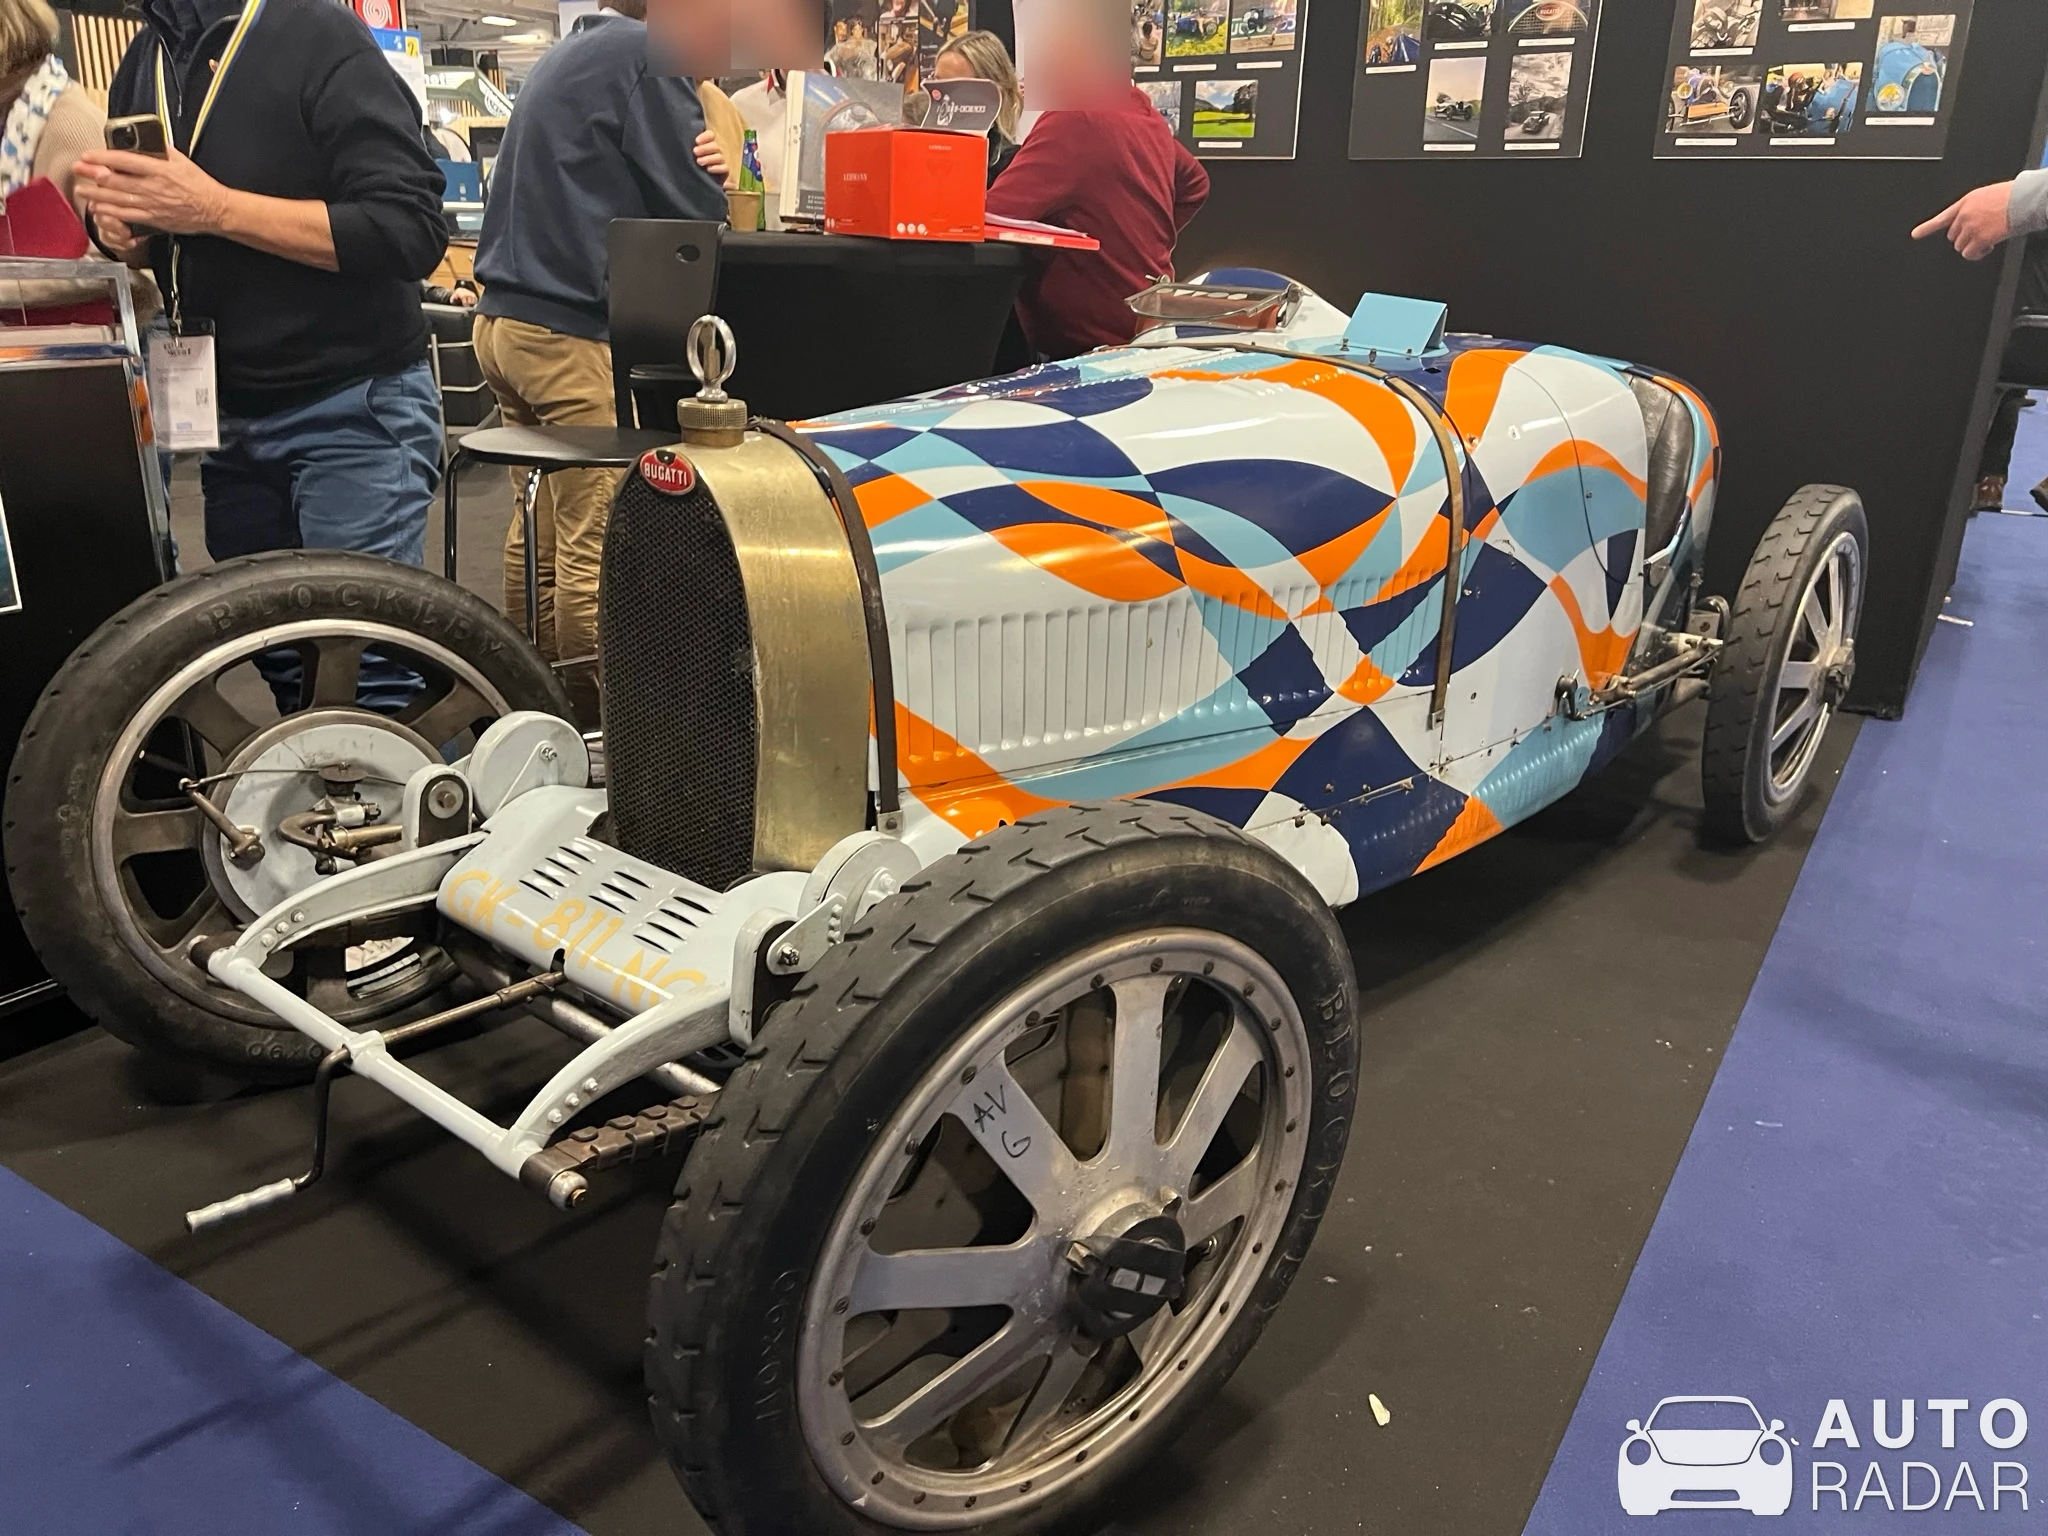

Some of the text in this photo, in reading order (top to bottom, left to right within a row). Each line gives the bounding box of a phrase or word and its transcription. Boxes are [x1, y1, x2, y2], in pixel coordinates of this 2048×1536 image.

[644, 462, 688, 486] BUGATTI
[202, 580, 508, 657] BLOCKLEY
[973, 1084, 1007, 1133] AV
[1001, 1131, 1031, 1158] G
